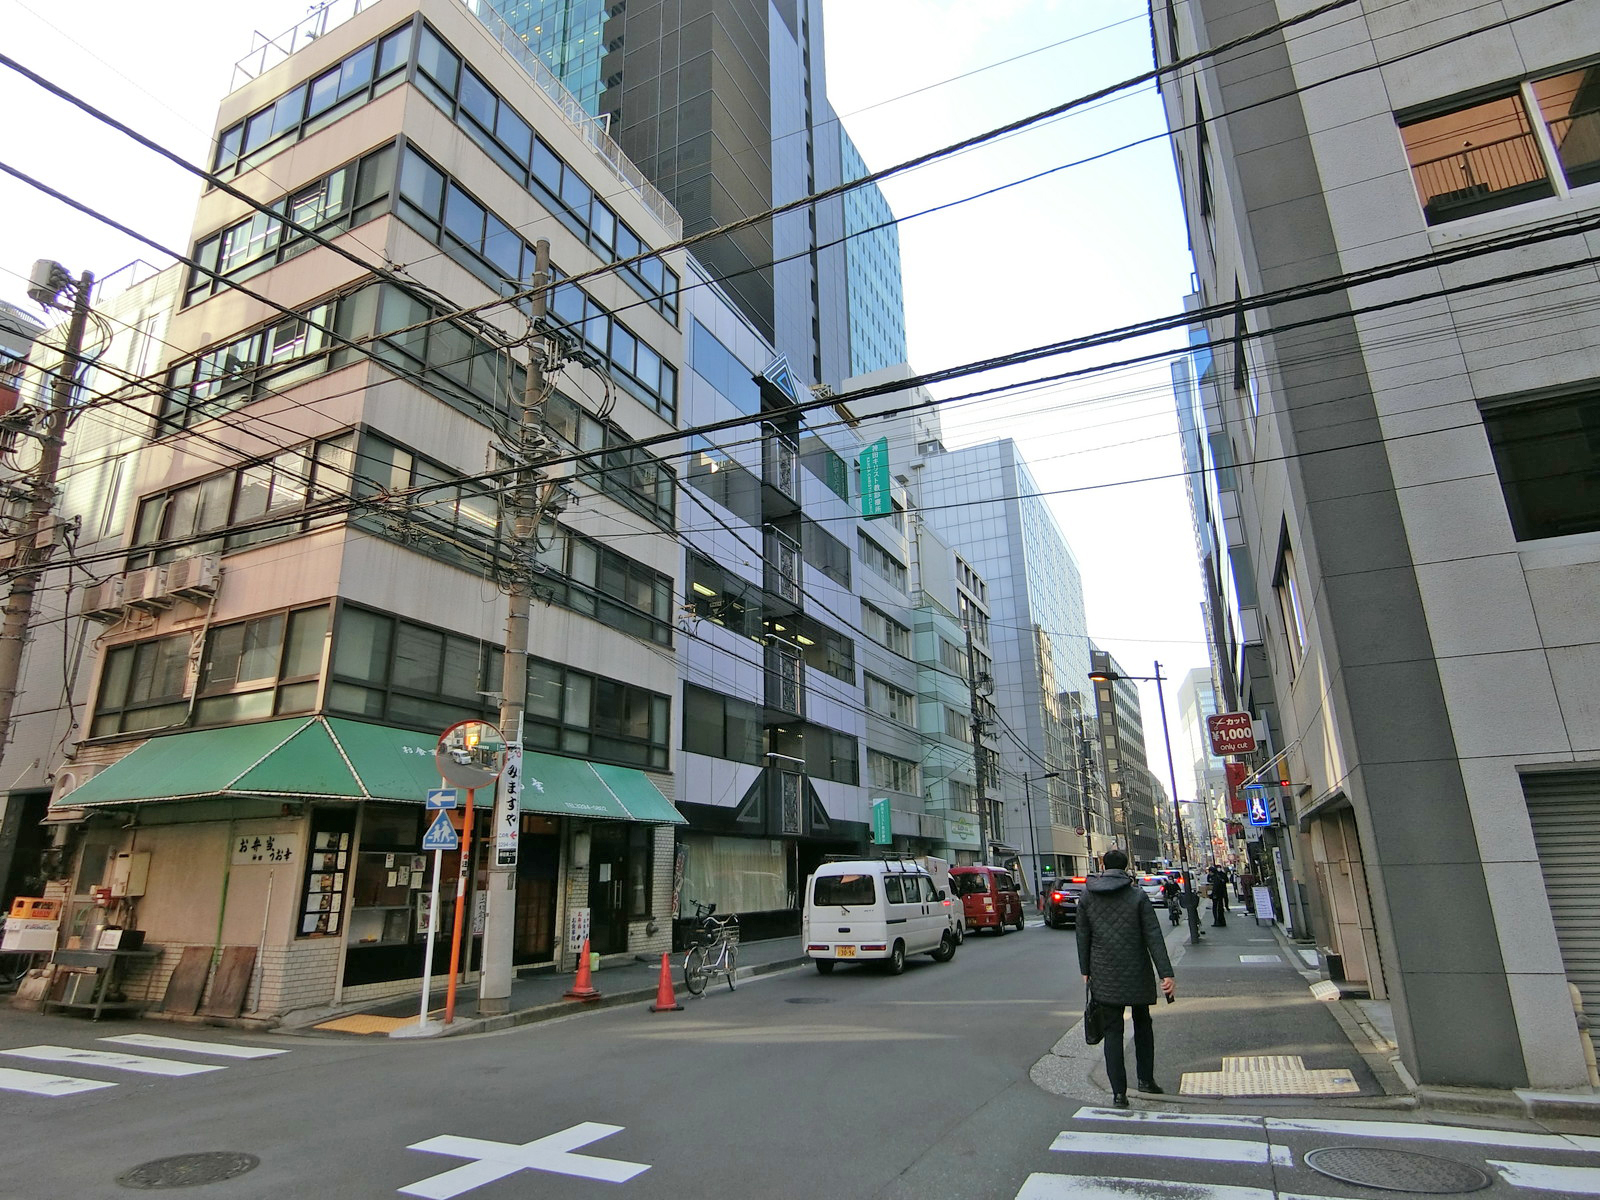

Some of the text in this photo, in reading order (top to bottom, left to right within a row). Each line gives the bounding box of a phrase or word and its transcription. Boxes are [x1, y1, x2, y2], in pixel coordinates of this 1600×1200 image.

[1226, 716, 1247, 726] カット
[1211, 727, 1252, 741] ¥1,000
[1220, 743, 1236, 751] only
[505, 764, 517, 827] みますや
